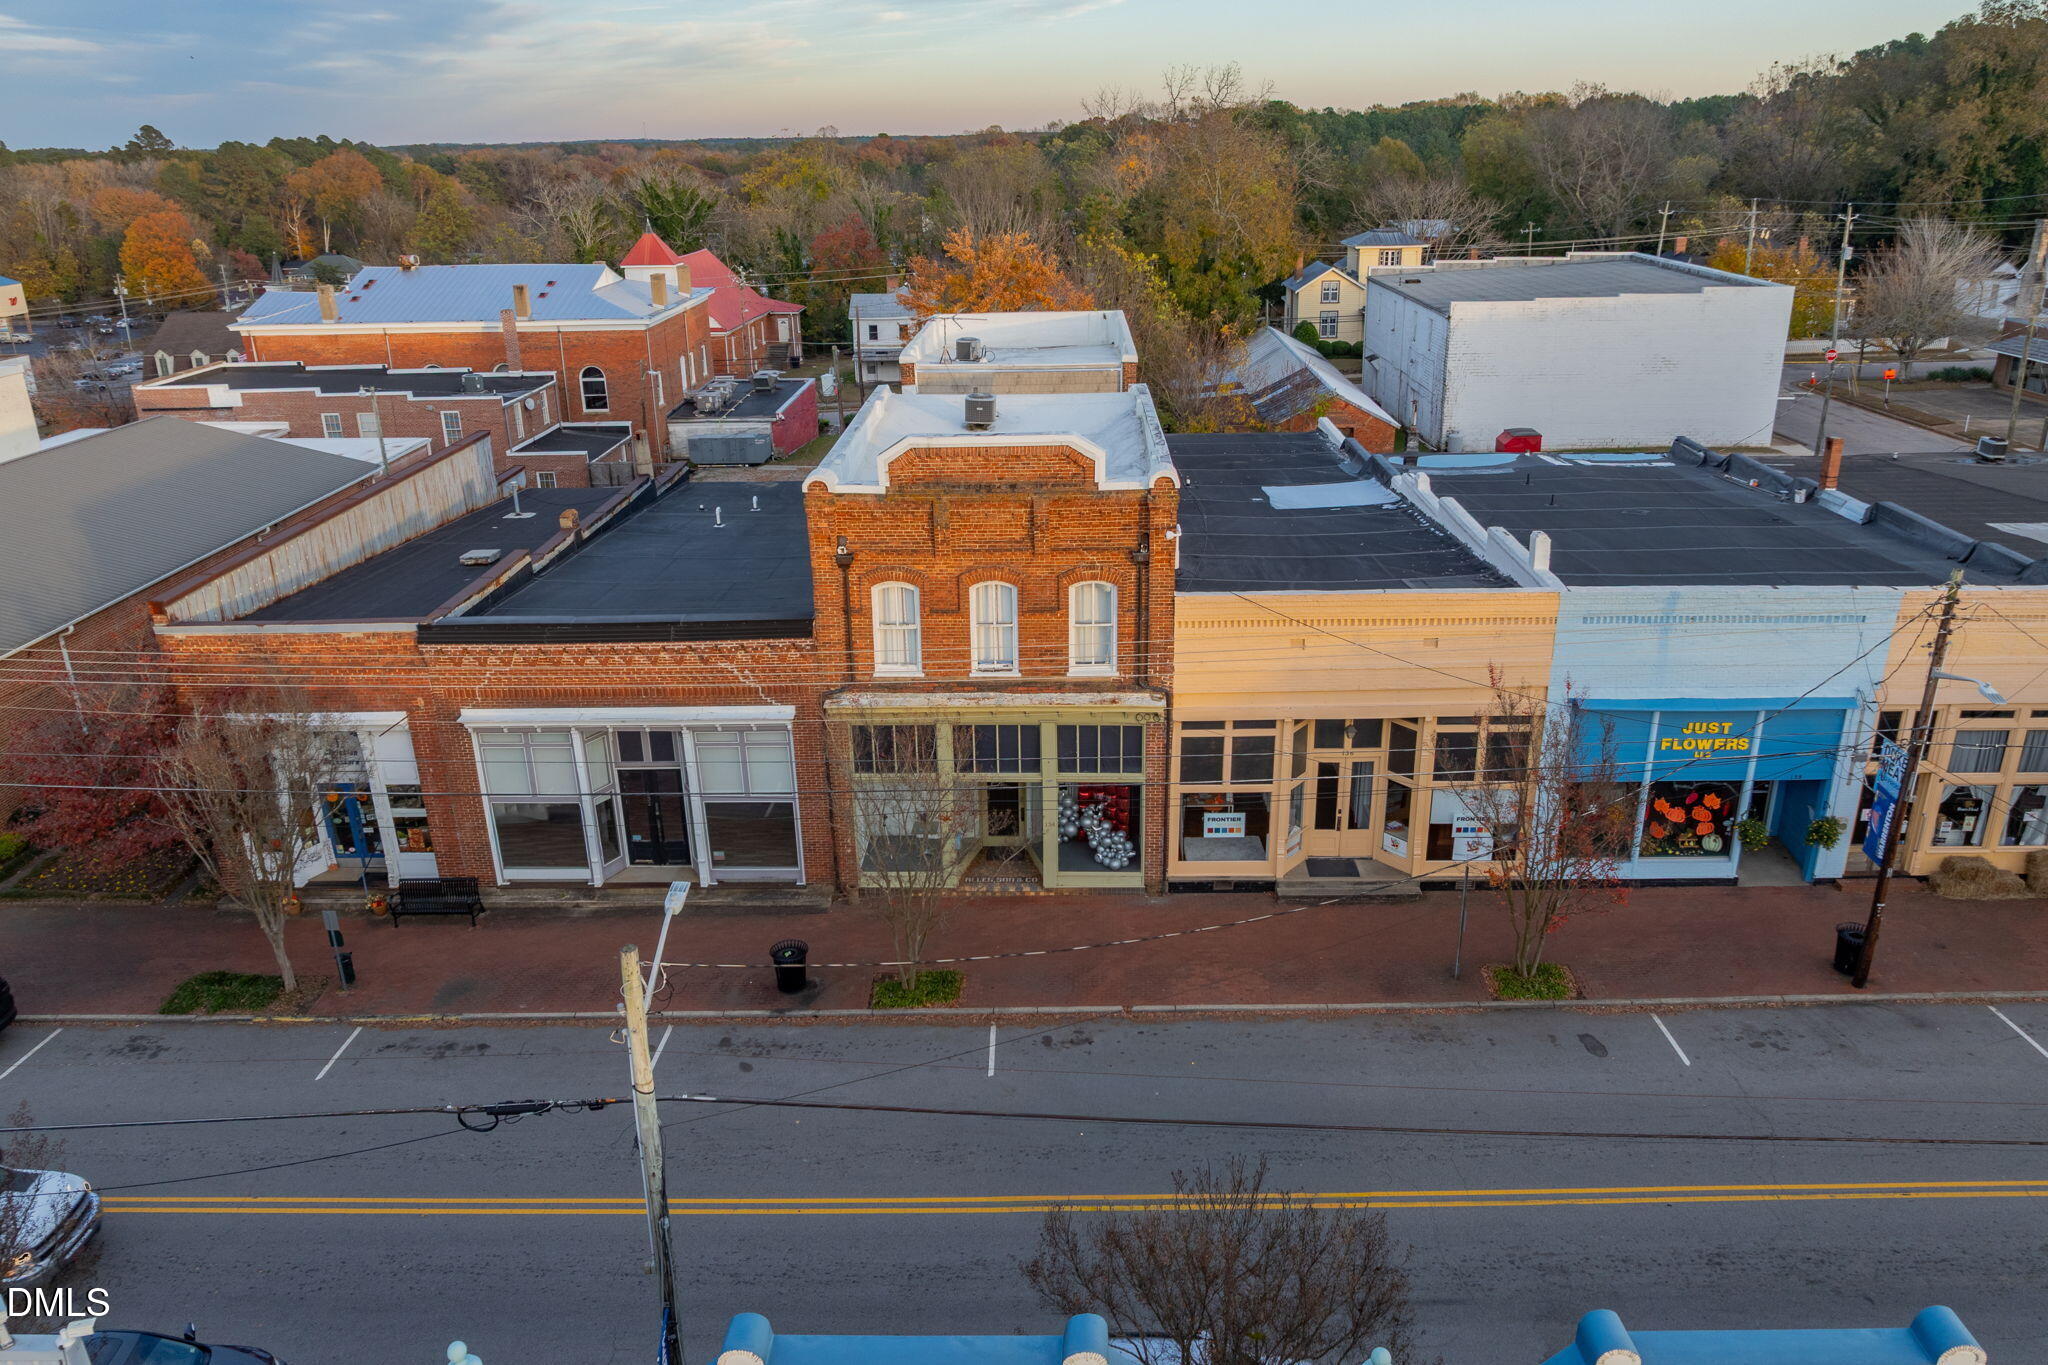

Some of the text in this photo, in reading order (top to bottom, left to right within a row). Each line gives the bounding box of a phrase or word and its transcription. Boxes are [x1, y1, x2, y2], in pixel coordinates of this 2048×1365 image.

[1681, 722, 1733, 735] JUST
[1660, 737, 1750, 751] FLOWERS
[1876, 802, 1896, 860] WARRENTON
